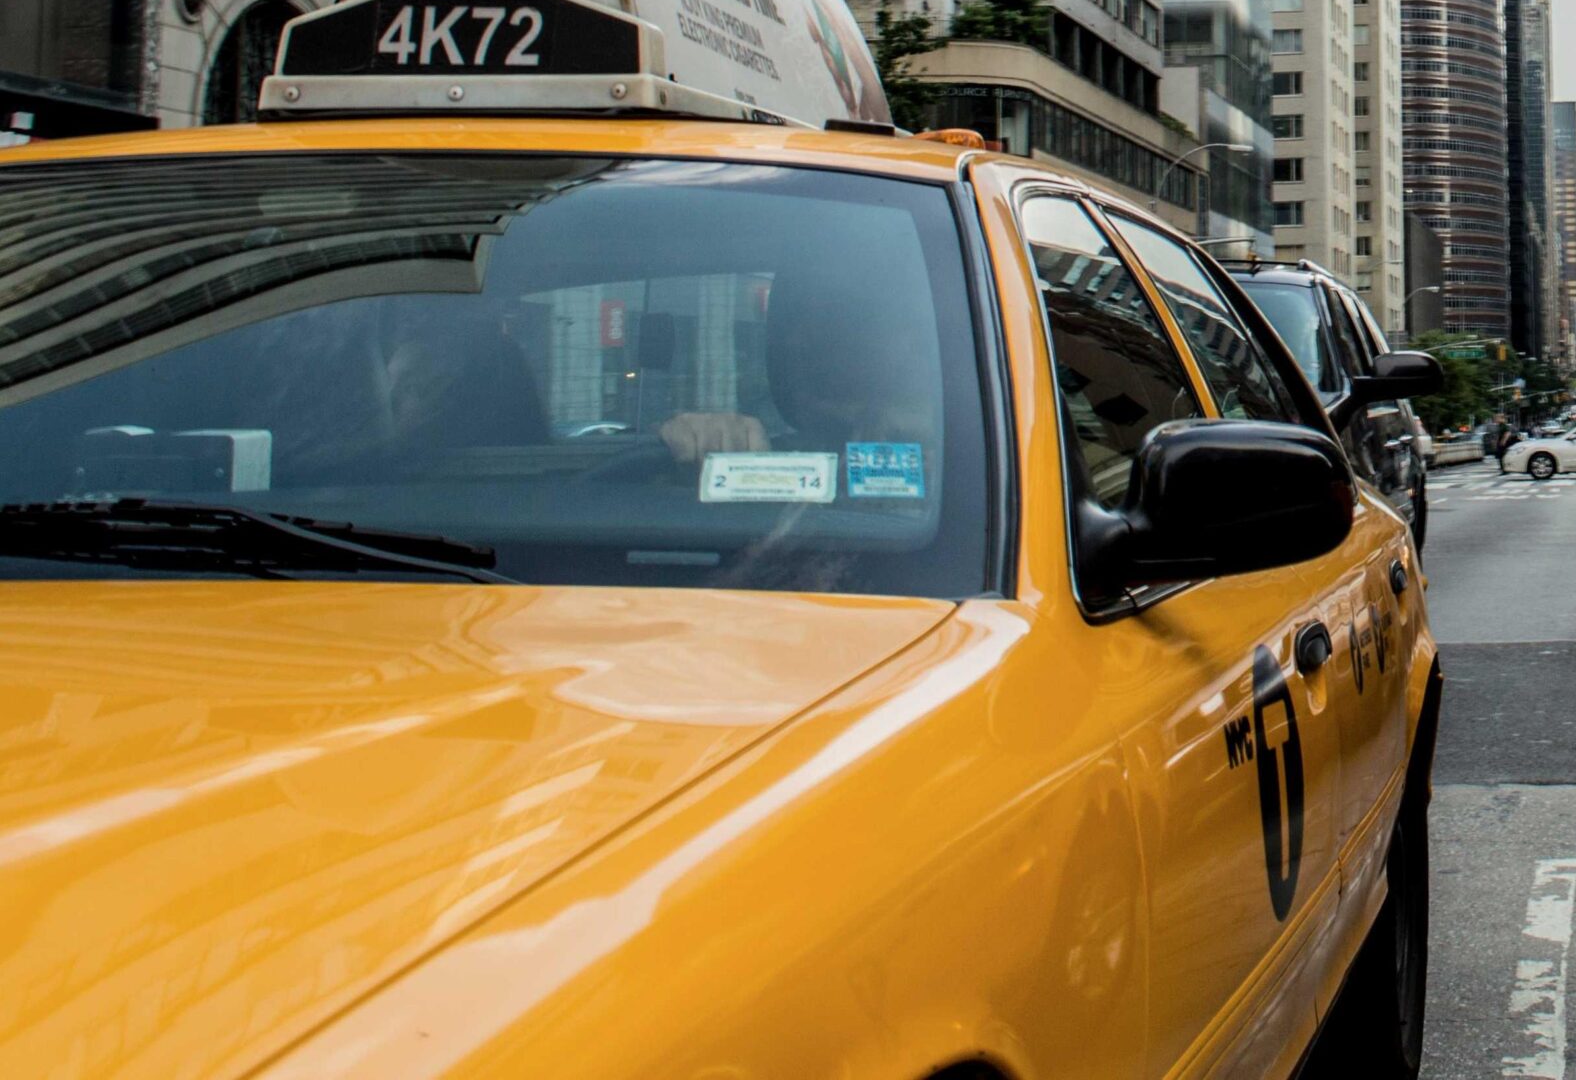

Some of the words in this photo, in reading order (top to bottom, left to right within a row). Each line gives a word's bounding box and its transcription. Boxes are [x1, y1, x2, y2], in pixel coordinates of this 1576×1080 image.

[378, 5, 543, 66] 4K72
[714, 475, 727, 488] 2
[799, 475, 822, 489] 14
[1223, 715, 1254, 770] NYC
